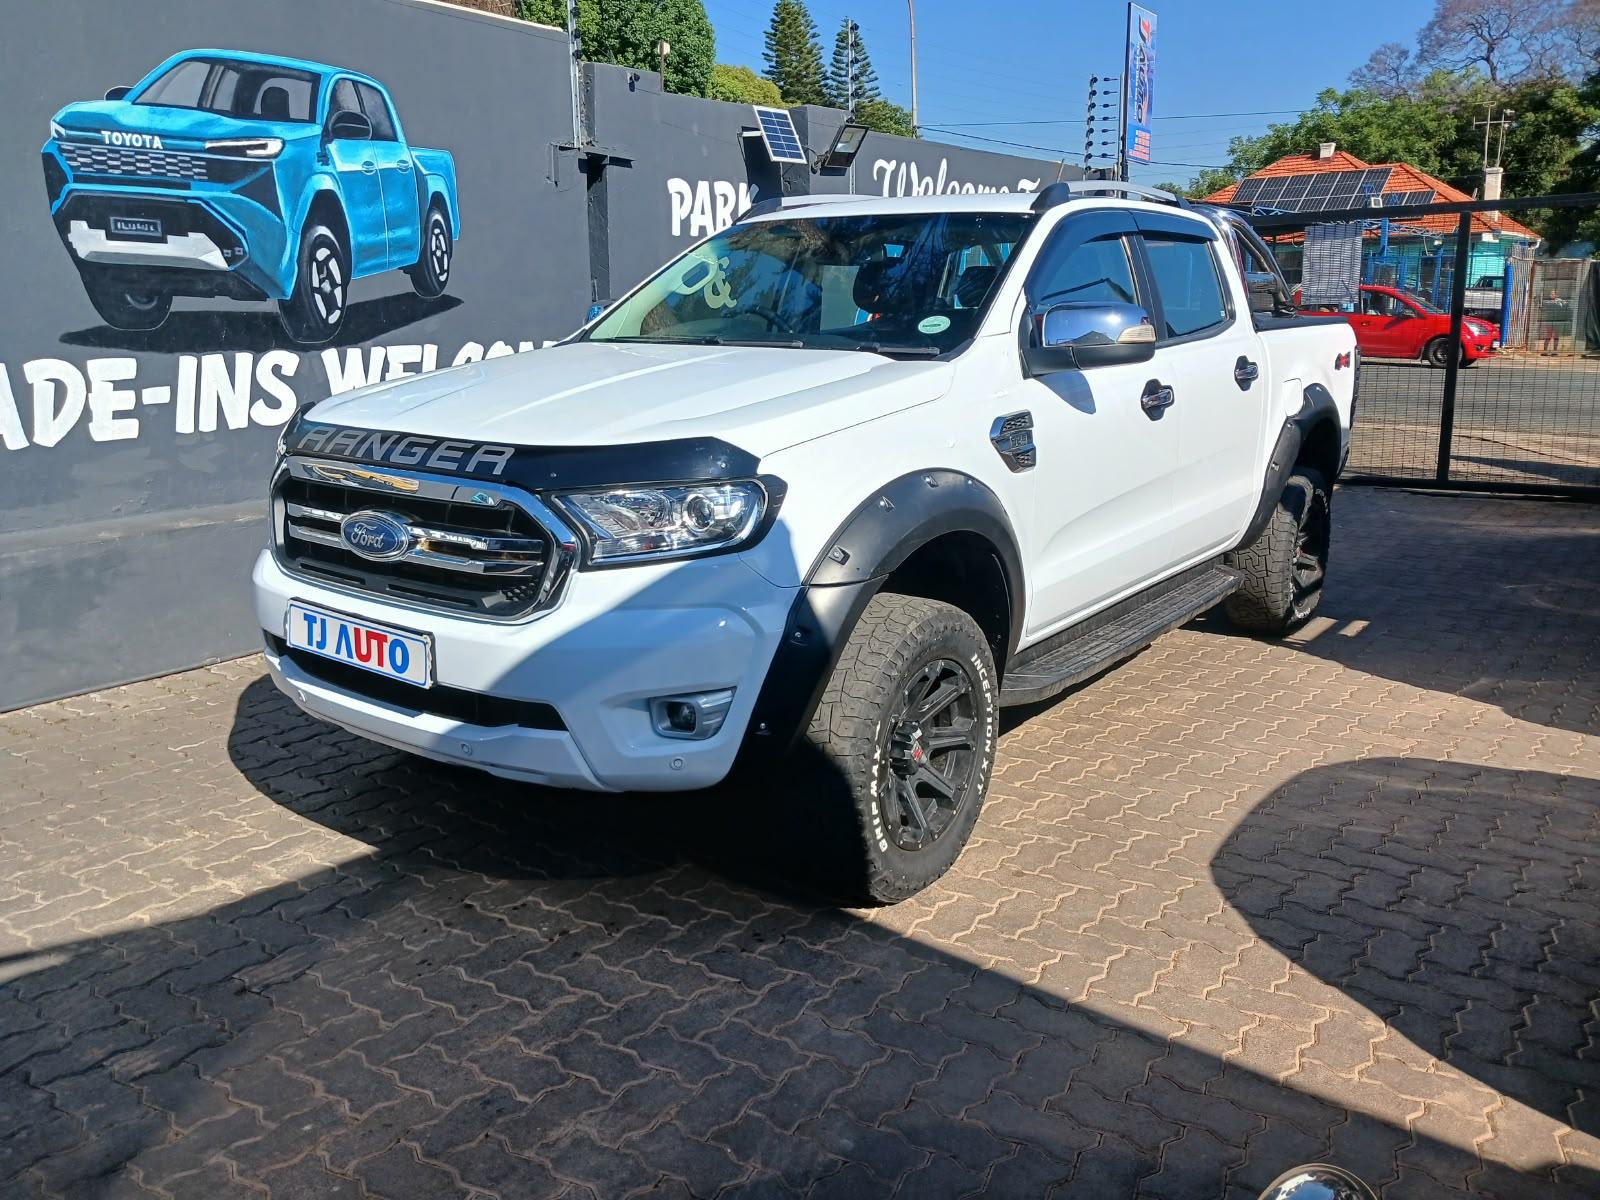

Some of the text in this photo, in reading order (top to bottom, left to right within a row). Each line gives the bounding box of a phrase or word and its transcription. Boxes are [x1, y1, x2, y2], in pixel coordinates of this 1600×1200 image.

[101, 130, 163, 149] TOYOTA
[297, 425, 515, 475] RANGER
[351, 523, 384, 549] Ford
[303, 612, 410, 674] TJ AUTO
[970, 652, 993, 753] INCEPTION
